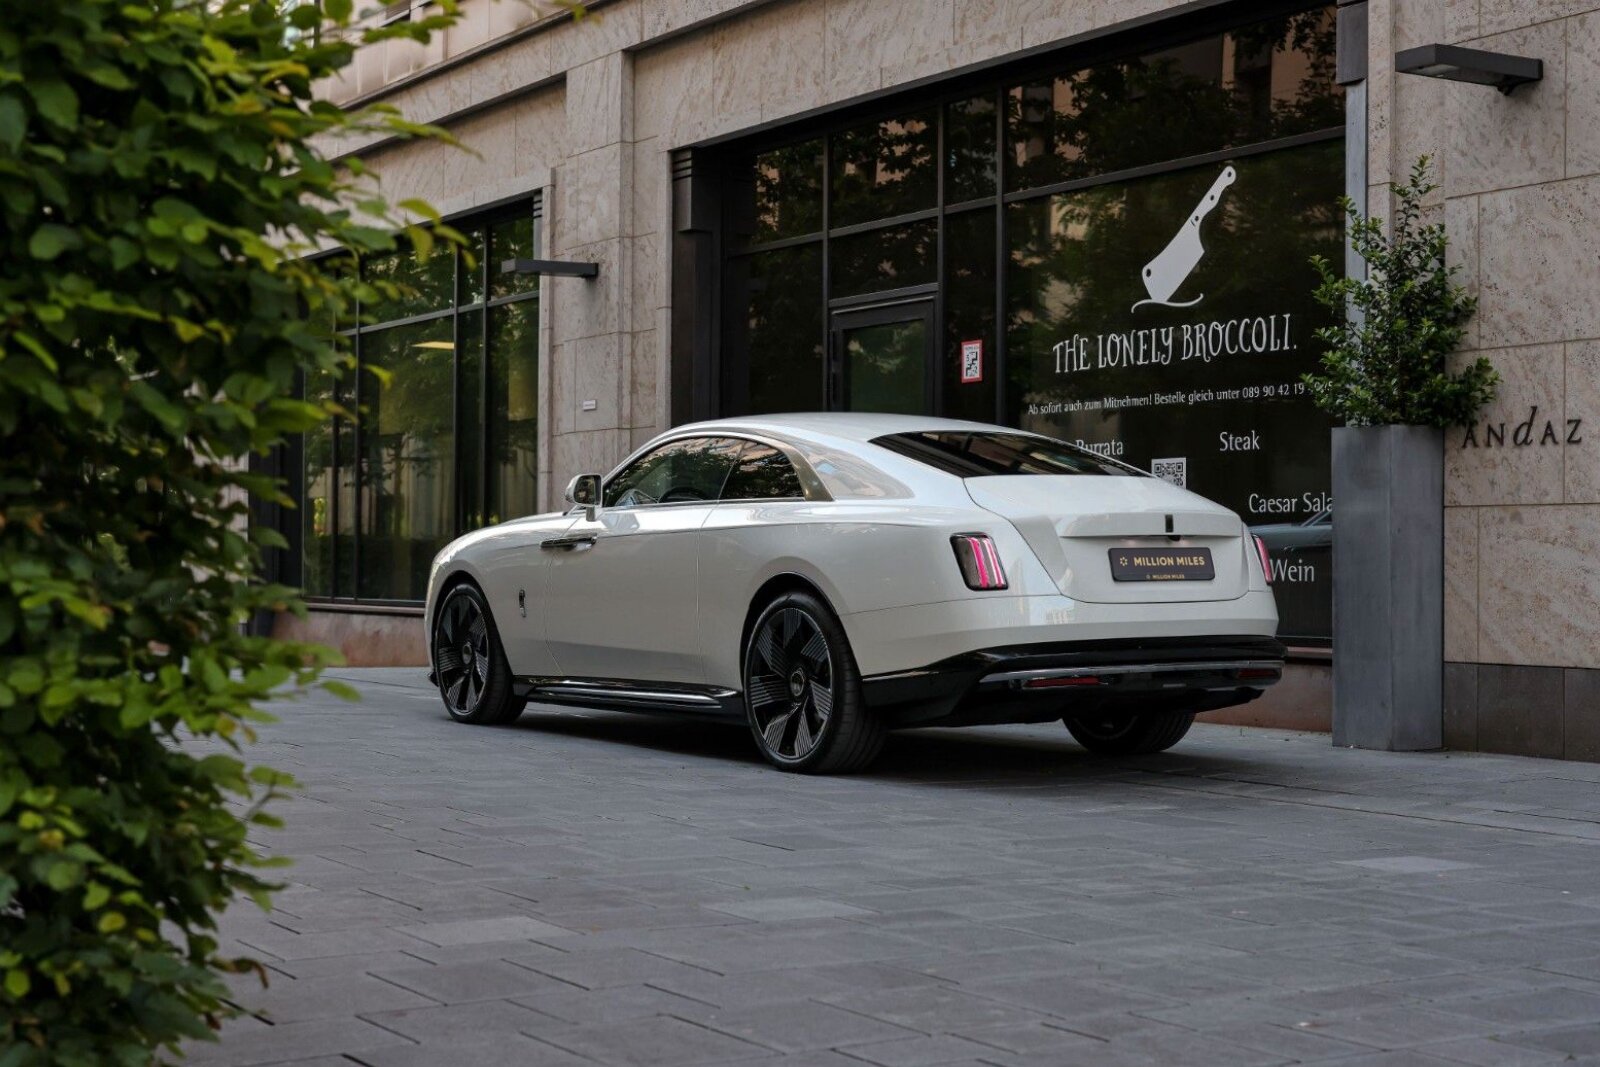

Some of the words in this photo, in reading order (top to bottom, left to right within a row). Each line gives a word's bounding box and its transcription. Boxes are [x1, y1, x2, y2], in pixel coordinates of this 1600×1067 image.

[1052, 333, 1091, 373] THE
[1097, 326, 1174, 366] LONELY
[1181, 313, 1297, 363] BROCCOLI.
[1028, 404, 1039, 415] Ab
[1040, 402, 1062, 414] sofort
[1064, 400, 1081, 412] auch
[1084, 400, 1101, 411] zum
[1103, 394, 1152, 409] Mitnehmen!
[1154, 391, 1186, 405] Bestelle
[1188, 389, 1214, 405] gleich
[1216, 388, 1240, 400] unter
[1242, 386, 1260, 398] 089
[1262, 385, 1275, 397] 90
[1278, 383, 1290, 396] 42
[1294, 382, 1305, 395] 19
[1219, 430, 1260, 452] Steak
[1248, 493, 1298, 513] Caesar
[1133, 556, 1174, 567] MILLION
[1176, 556, 1205, 566] MILES
[1269, 559, 1315, 582] Wein
